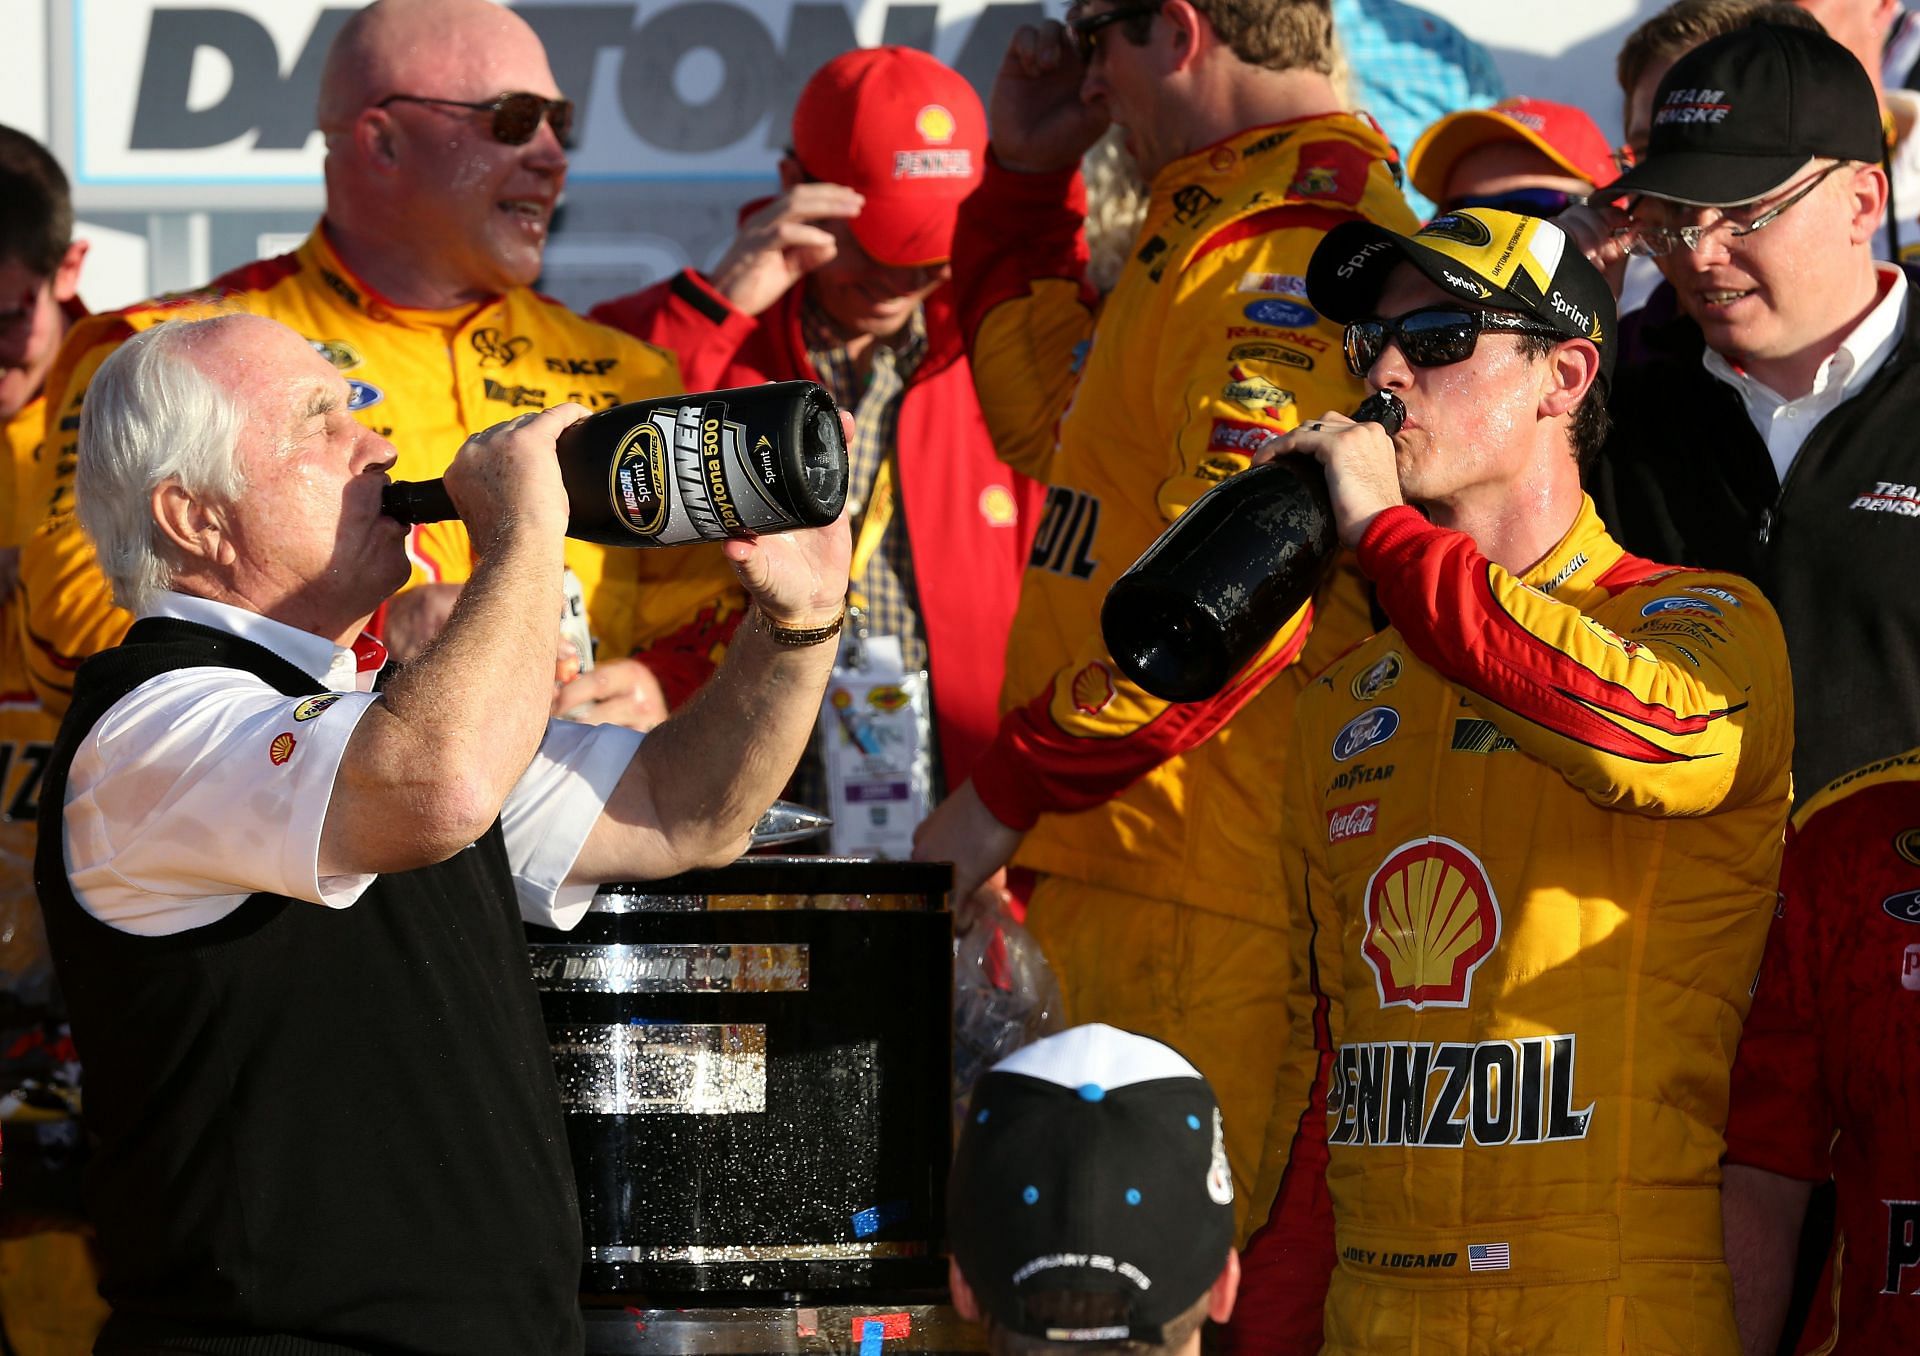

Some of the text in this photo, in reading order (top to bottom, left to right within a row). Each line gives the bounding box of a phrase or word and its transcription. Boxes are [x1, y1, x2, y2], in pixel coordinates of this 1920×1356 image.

[1666, 88, 1725, 104] TEAM
[1337, 241, 1393, 279] Sprin
[1491, 250, 1511, 277] DAYTONA
[1443, 270, 1479, 295] Sprint
[1550, 290, 1591, 333] Sprint
[633, 461, 651, 504] Sprint
[651, 435, 664, 497] CUP SERIES
[675, 405, 729, 539] WINNER
[704, 418, 740, 528] Daytona 500
[760, 450, 776, 485] Sprint
[1873, 481, 1920, 502] TEA
[1345, 711, 1385, 755] Ford
[1327, 1033, 1596, 1149] PENNZOIL
[1342, 1245, 1459, 1269] JOEY LOGANO
